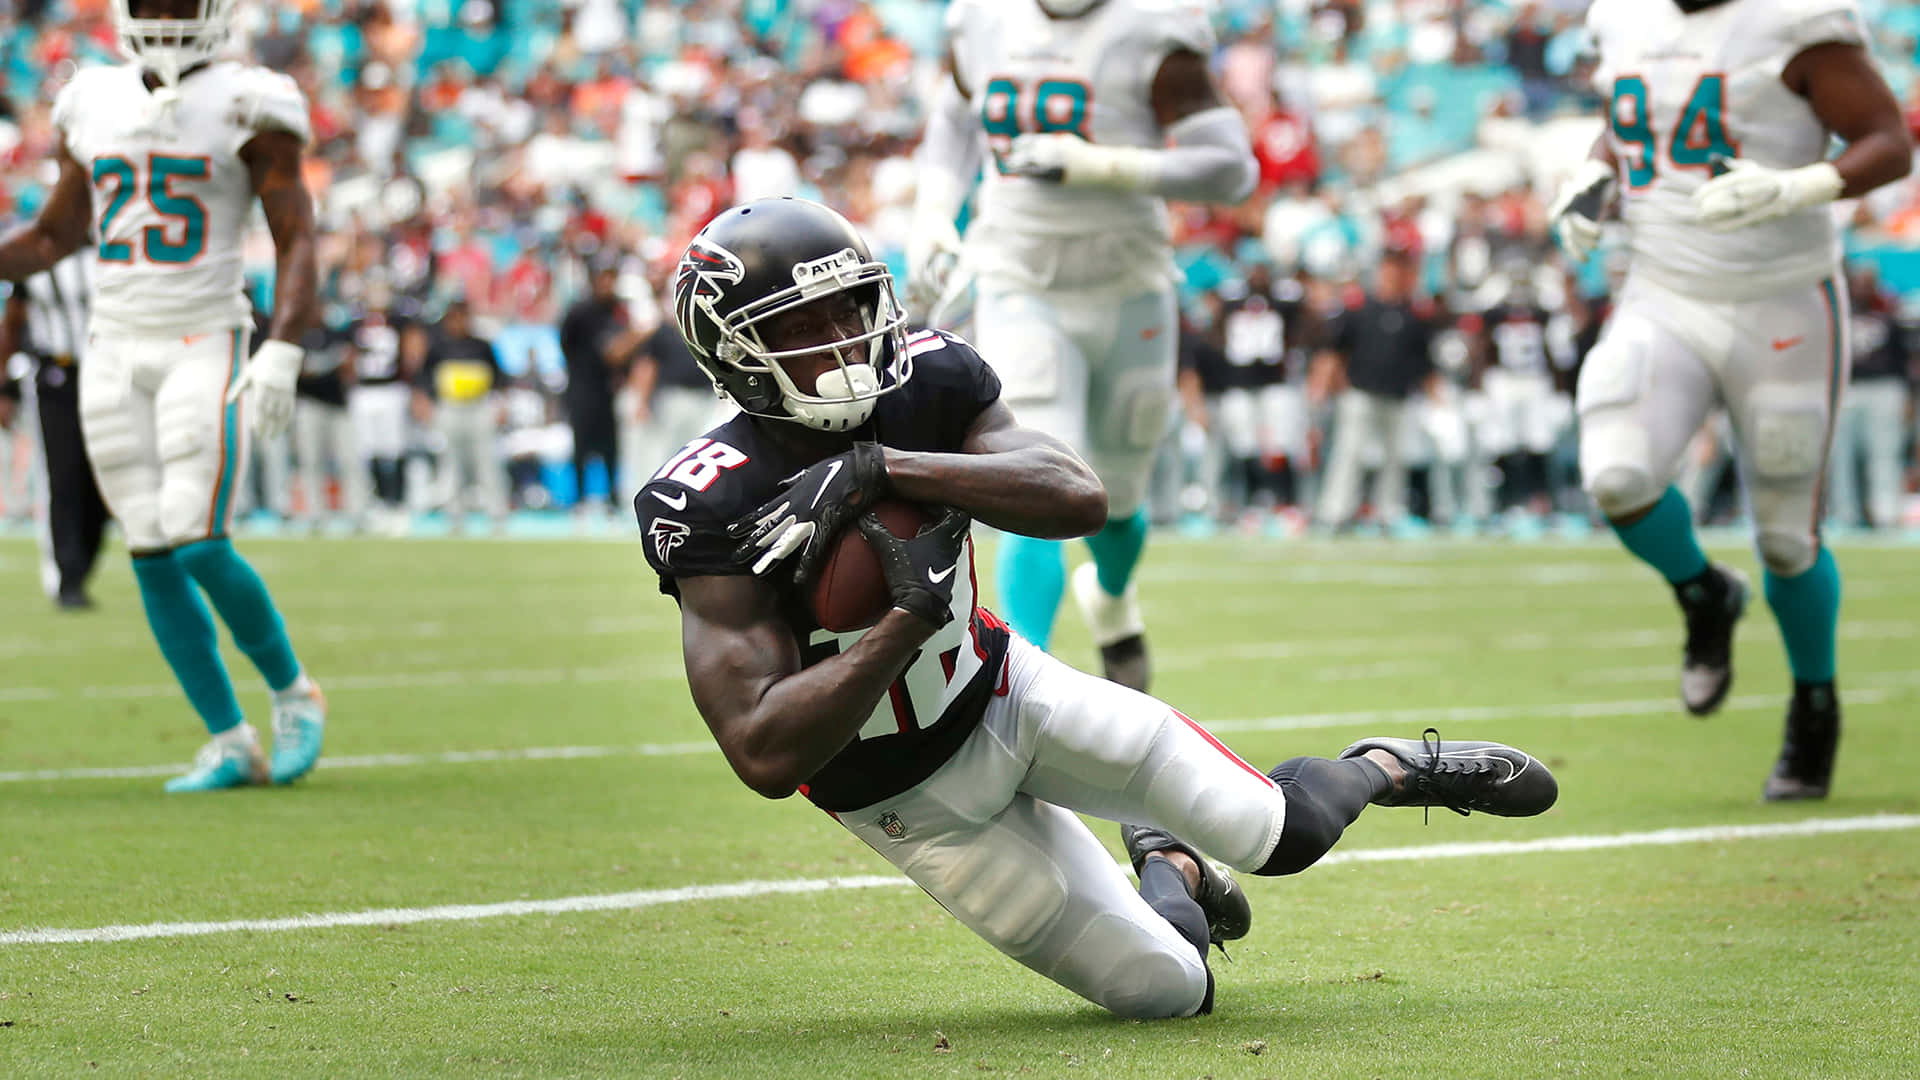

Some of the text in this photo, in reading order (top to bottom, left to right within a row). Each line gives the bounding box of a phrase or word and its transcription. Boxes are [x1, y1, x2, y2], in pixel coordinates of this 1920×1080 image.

[1609, 72, 1741, 192] 94
[92, 152, 211, 268] 25
[811, 259, 843, 276] ATL
[651, 438, 751, 493] 18
